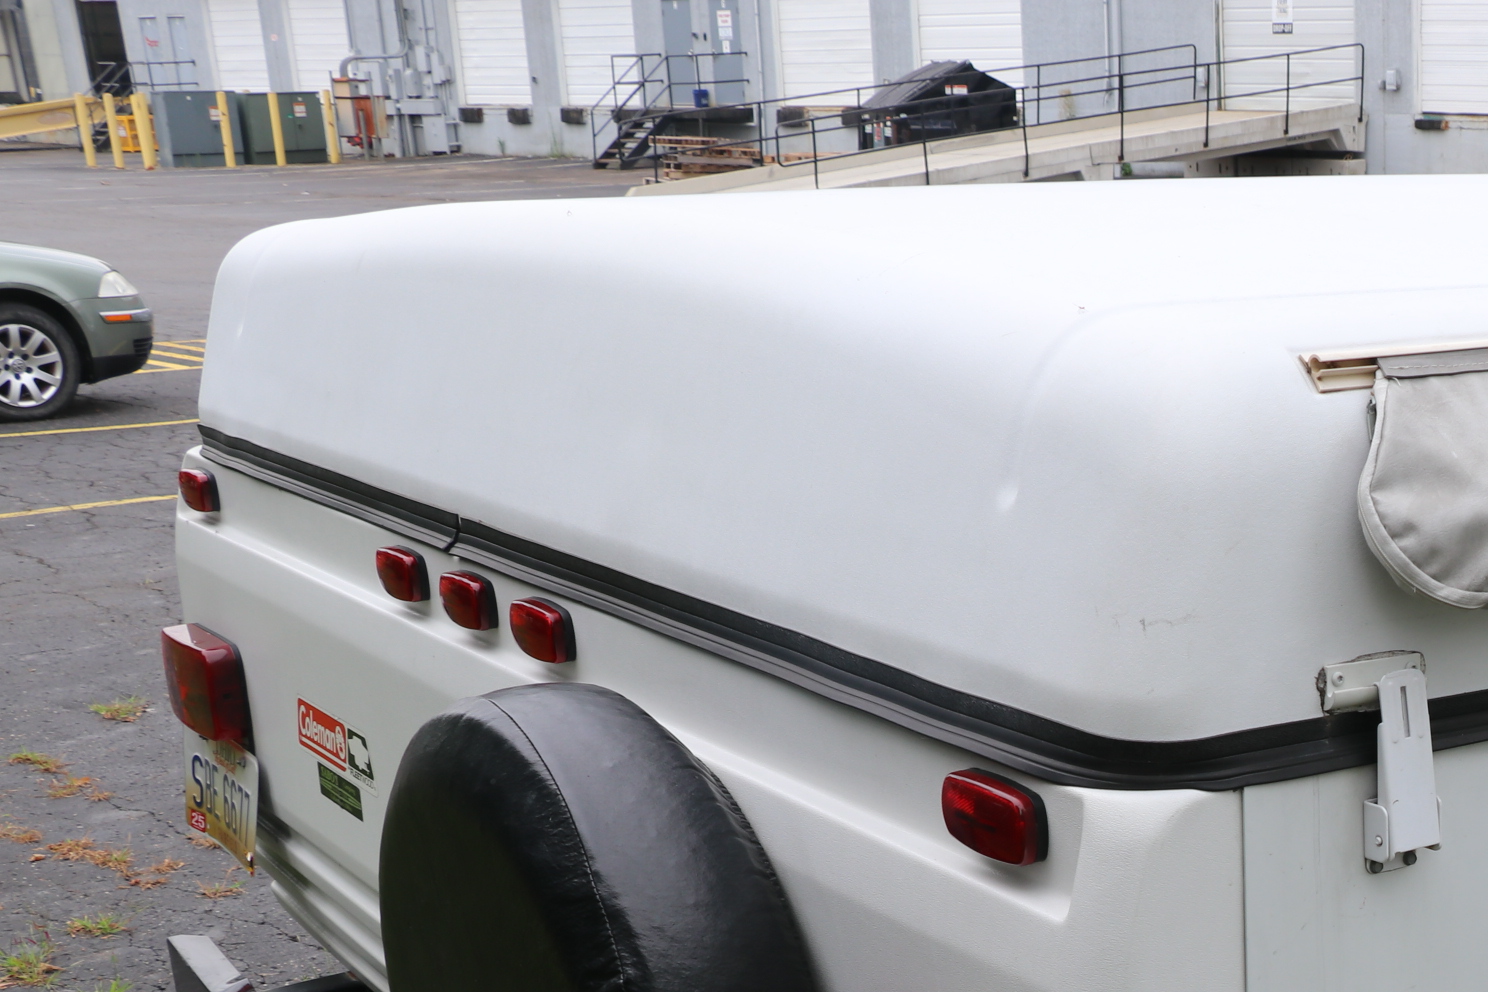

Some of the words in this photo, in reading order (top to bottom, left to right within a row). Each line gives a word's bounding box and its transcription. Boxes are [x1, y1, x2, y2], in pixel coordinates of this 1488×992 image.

[299, 704, 337, 754] Coleman
[191, 754, 220, 822] SBE
[223, 773, 251, 849] 6677
[191, 811, 206, 829] 25
